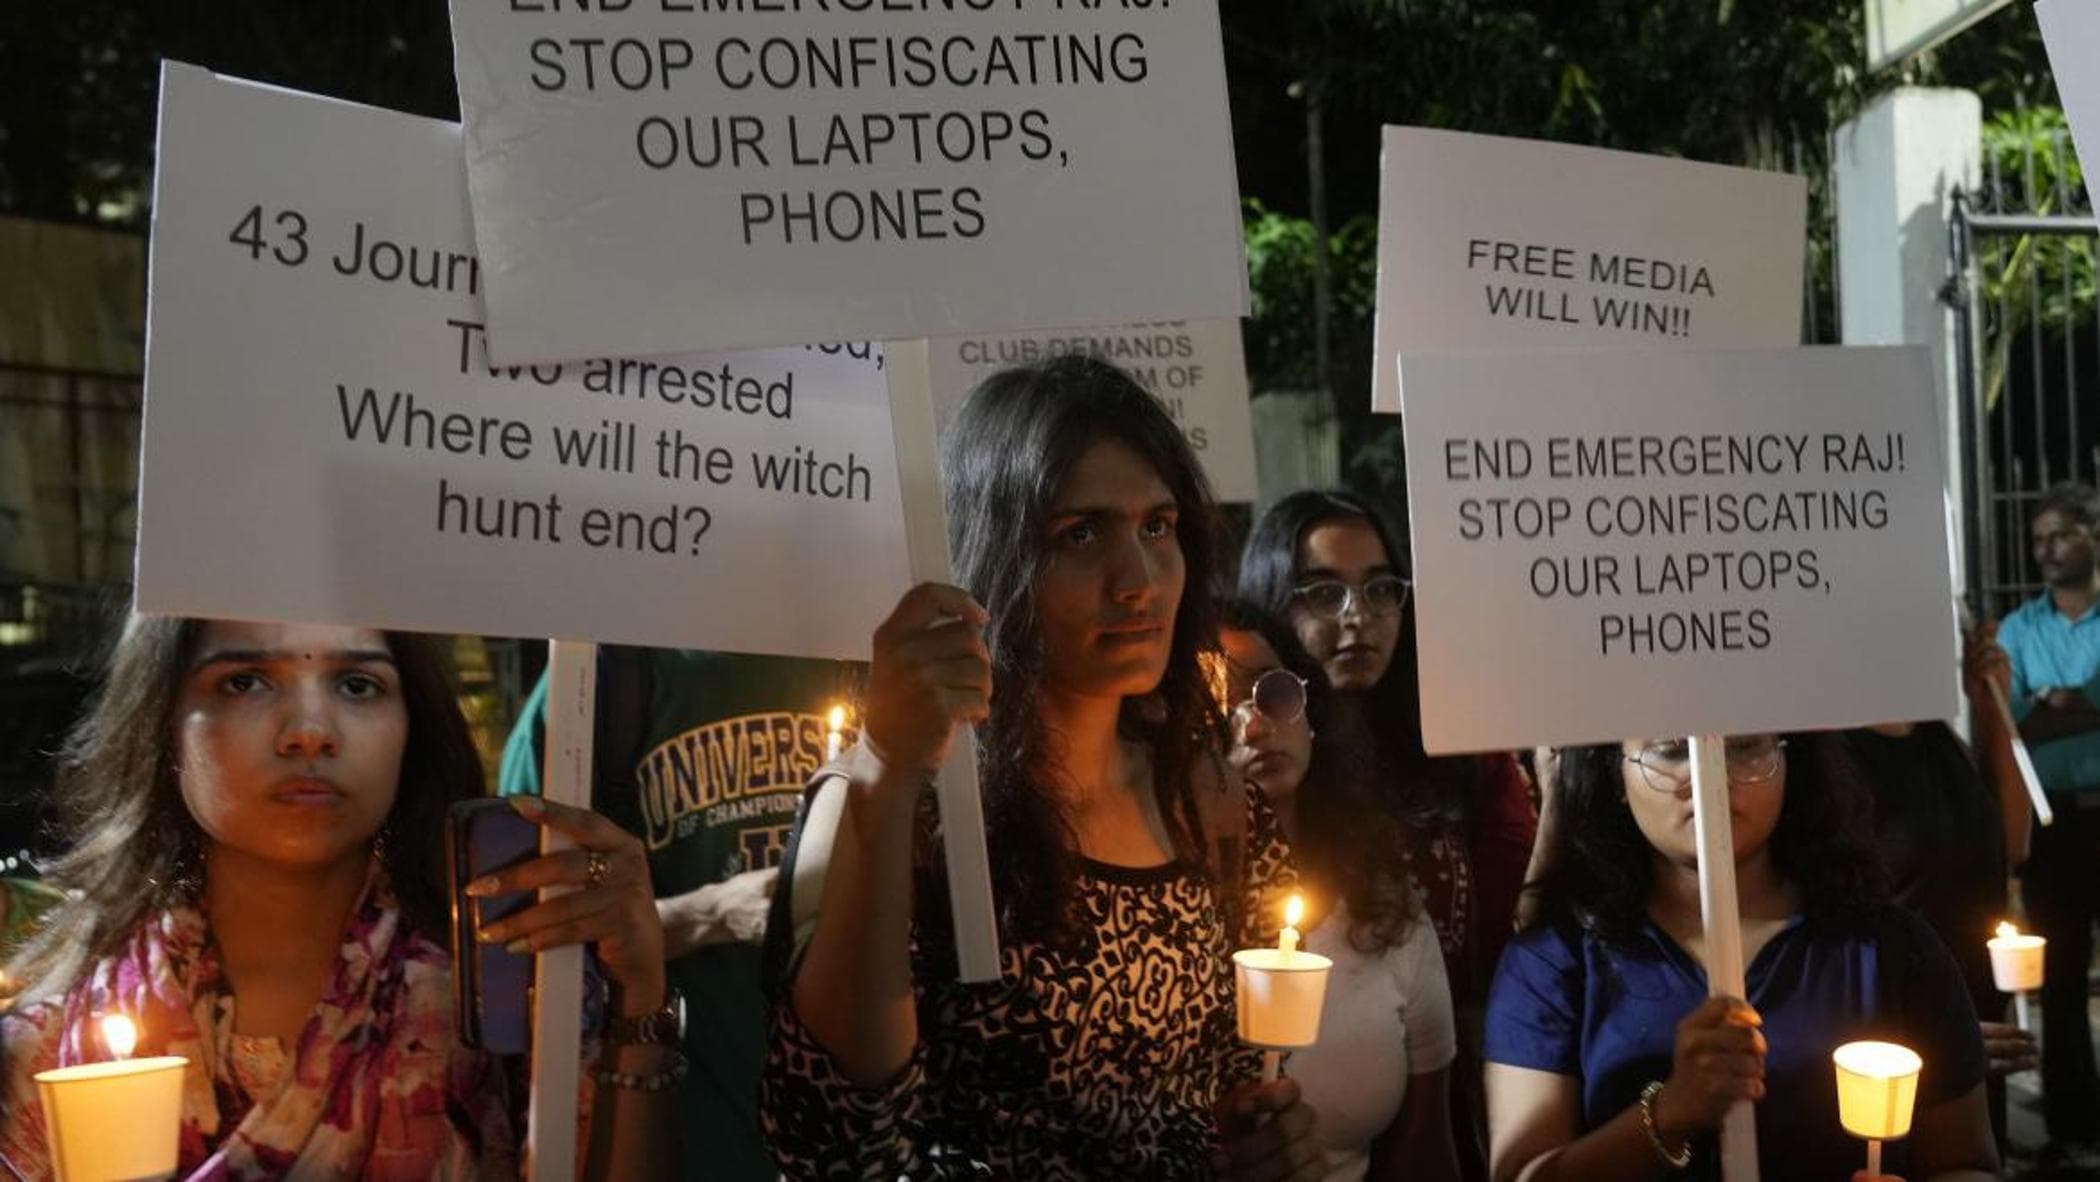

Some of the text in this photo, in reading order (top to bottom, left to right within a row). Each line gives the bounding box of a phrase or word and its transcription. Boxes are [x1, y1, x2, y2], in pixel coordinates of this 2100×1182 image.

[528, 32, 1149, 92] STOP CONFISCATING
[635, 109, 1069, 171] OUR LAPTOPS,
[228, 204, 310, 267] 43
[739, 186, 987, 246] PHONES
[1466, 238, 1717, 299] FREE MEDIA
[1485, 284, 1692, 338] WILL WIN!!
[959, 336, 1193, 364] CLUB DEMANDS
[1166, 366, 1204, 389] OF
[582, 357, 793, 420] arrested
[335, 383, 872, 503] Where will the witch
[1444, 432, 1906, 481] END EMERGENCY RAJ!
[437, 479, 713, 557] hunt end?
[1457, 489, 1890, 541] STOP CONFISCATING
[1528, 549, 1832, 600] OUR LAPTOPS,
[1599, 608, 1773, 656] PHONES
[637, 712, 829, 849] UNIVERS
